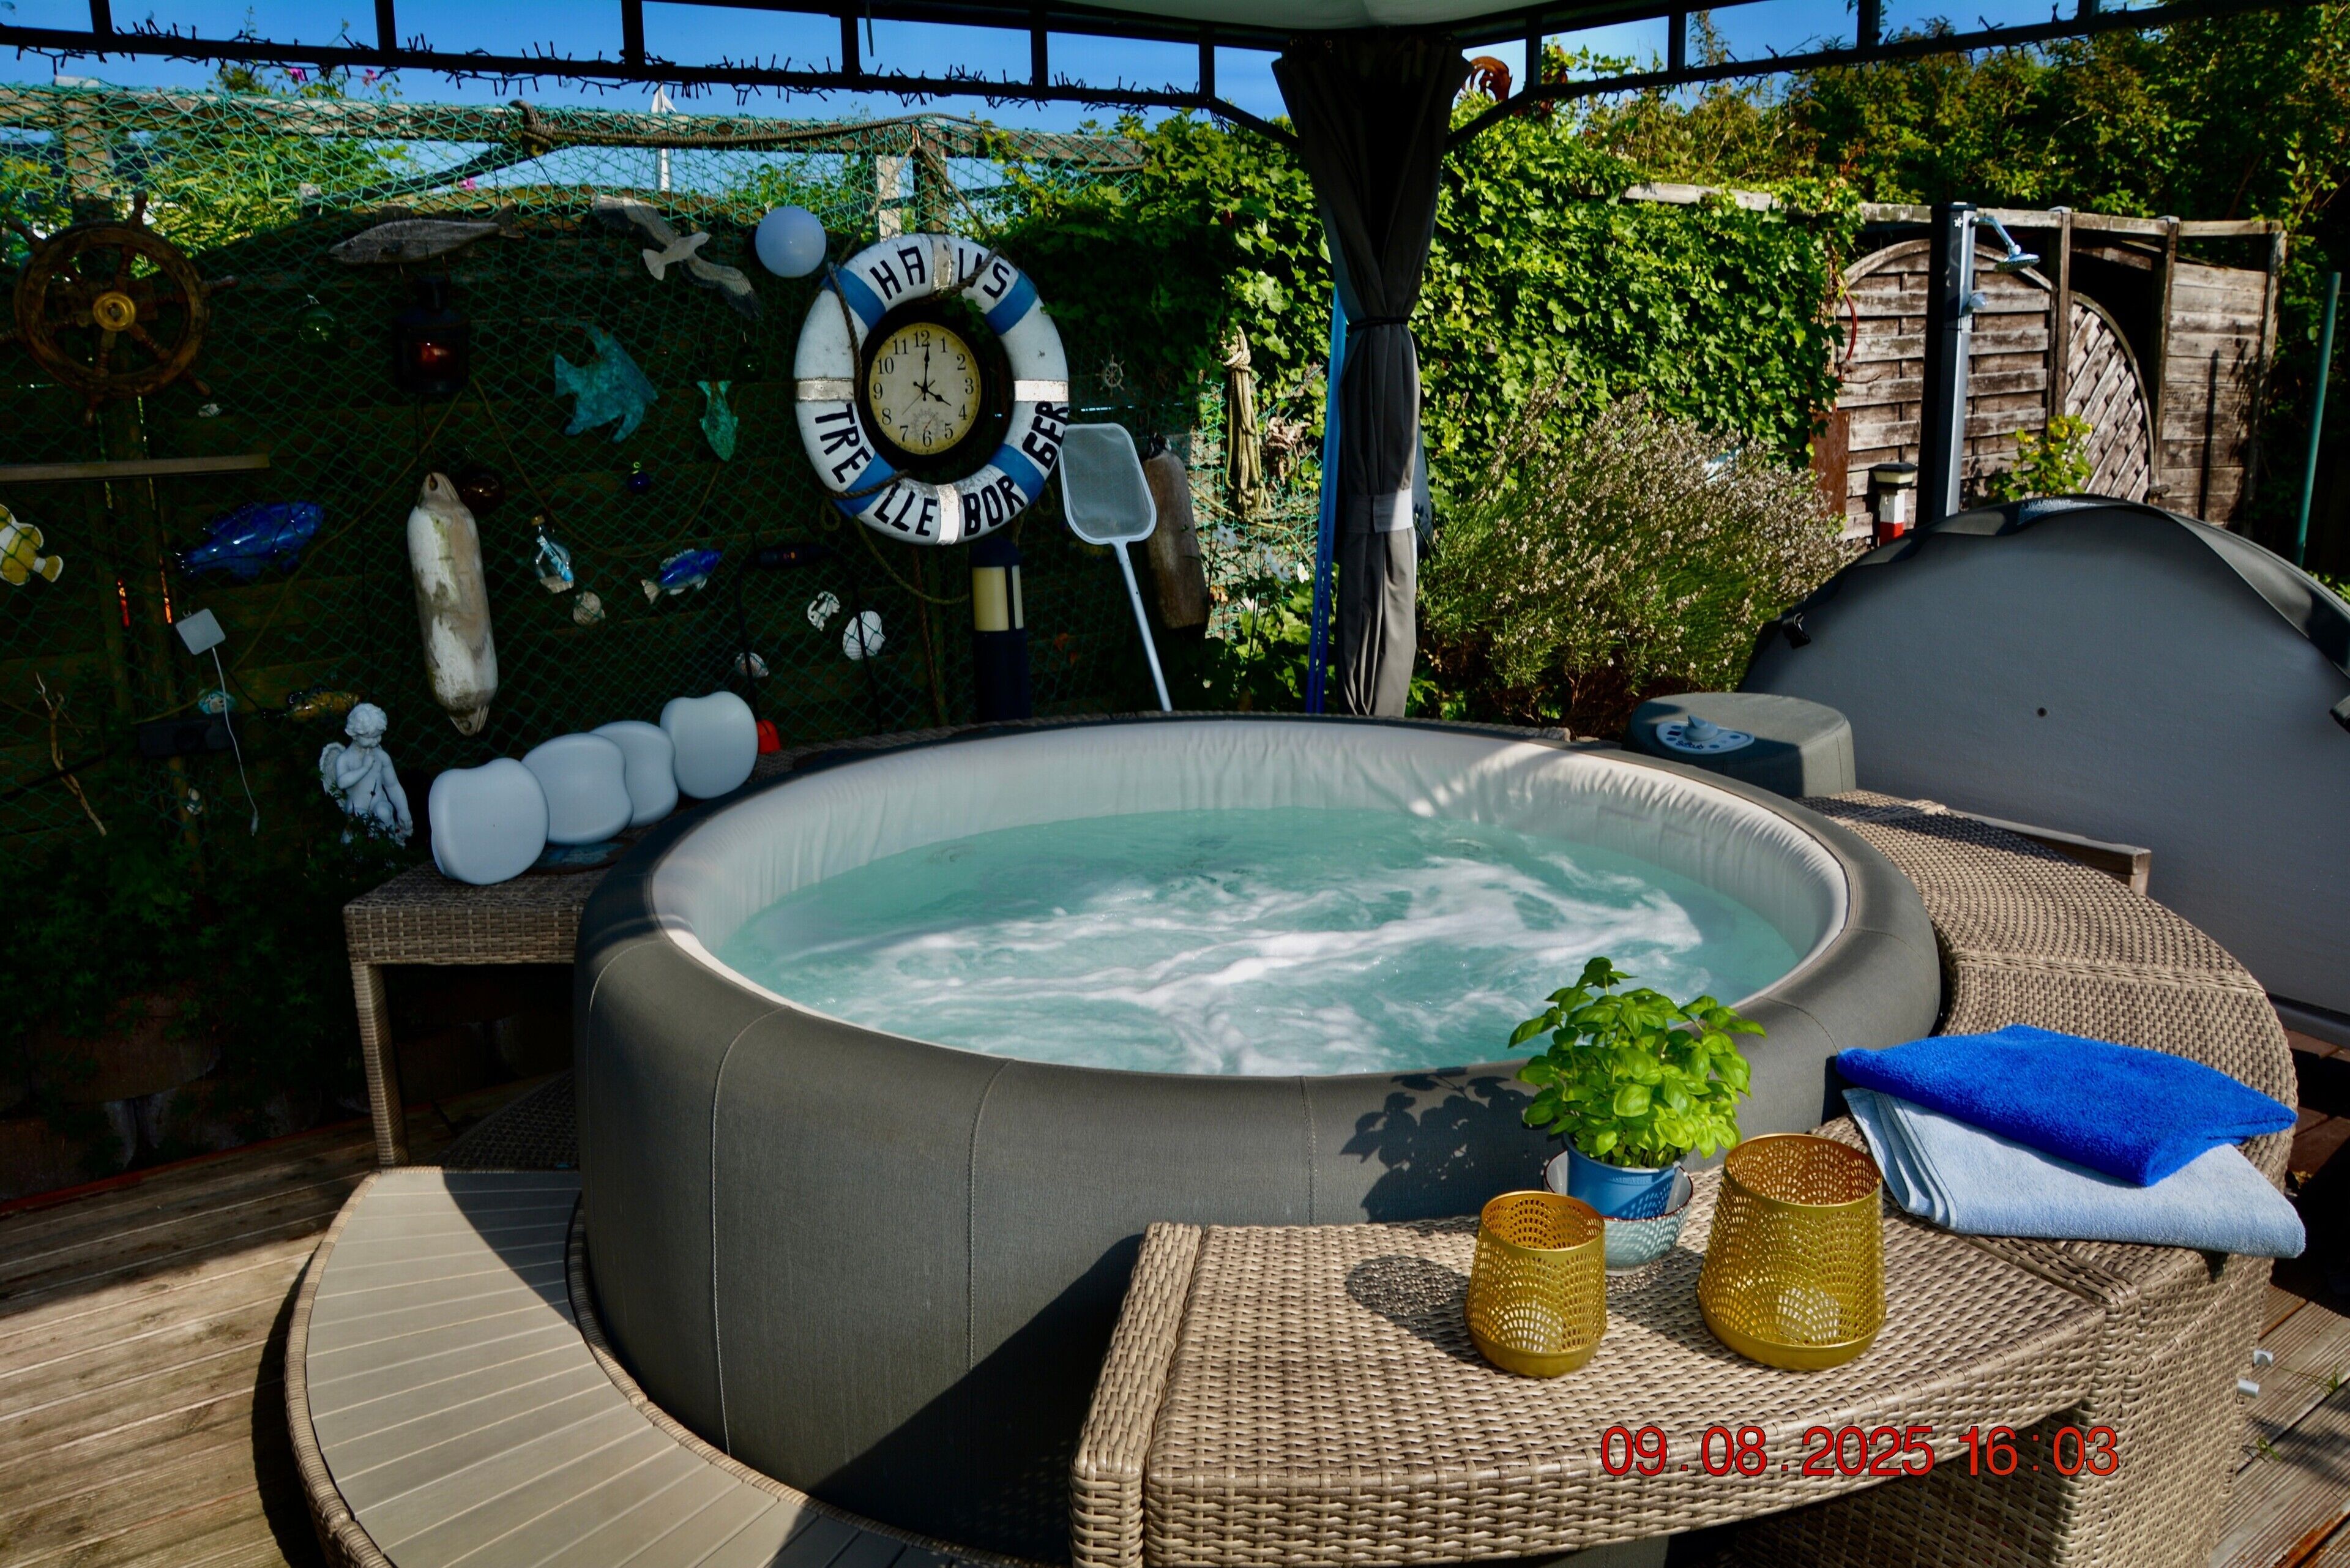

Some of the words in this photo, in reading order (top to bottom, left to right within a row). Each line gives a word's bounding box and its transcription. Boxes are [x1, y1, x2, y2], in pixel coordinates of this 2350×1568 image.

[893, 338, 908, 355] 11
[914, 329, 930, 348] 12
[941, 336, 948, 353] 1
[878, 357, 894, 375] 10
[957, 354, 966, 371] 2
[873, 383, 883, 400] 9
[964, 378, 974, 395] 3
[882, 408, 892, 425] 8
[958, 404, 968, 421] 4
[900, 425, 909, 442] 7
[922, 430, 932, 447] 6
[944, 423, 953, 439] 5
